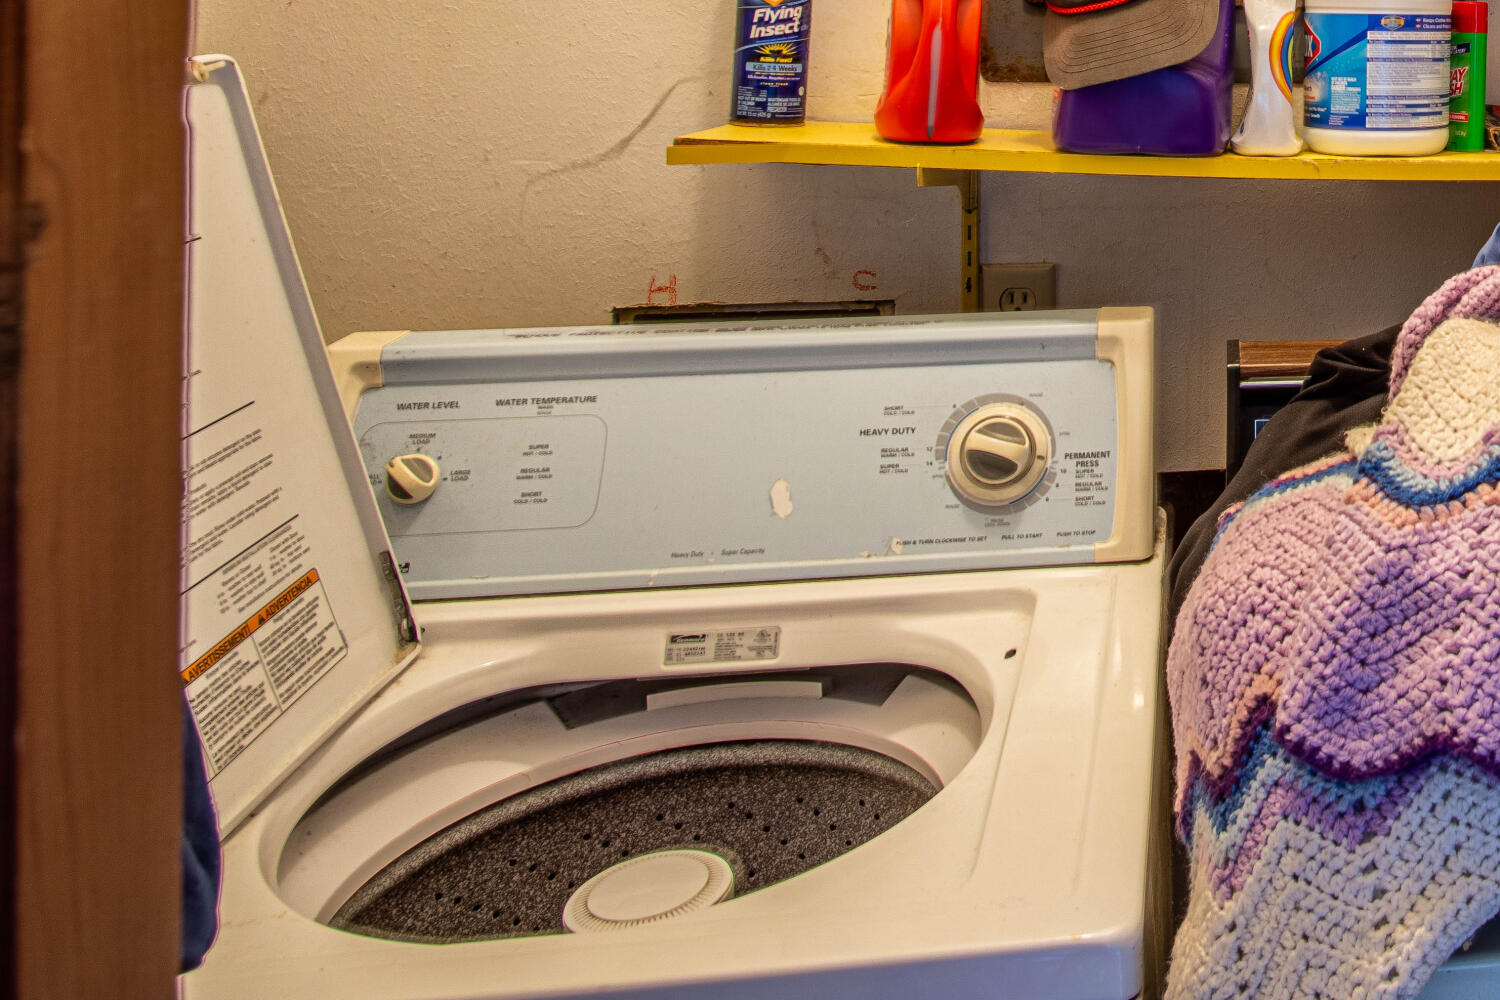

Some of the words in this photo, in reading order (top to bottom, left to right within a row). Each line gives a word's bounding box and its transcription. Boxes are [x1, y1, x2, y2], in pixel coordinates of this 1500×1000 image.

[753, 5, 803, 24] Flying
[750, 16, 801, 38] Insect
[395, 400, 430, 411] WATER
[430, 399, 461, 410] LEVEL
[494, 396, 529, 408] WATER
[529, 393, 598, 406] TEMPERATURE
[858, 427, 889, 437] HEAVY
[890, 425, 917, 436] DUTY
[1063, 449, 1111, 461] PERMANENT
[1074, 459, 1099, 468] PRESS
[448, 469, 472, 477] LARGE
[450, 473, 469, 483] LOAD
[264, 576, 311, 617] ADVERTENCIA
